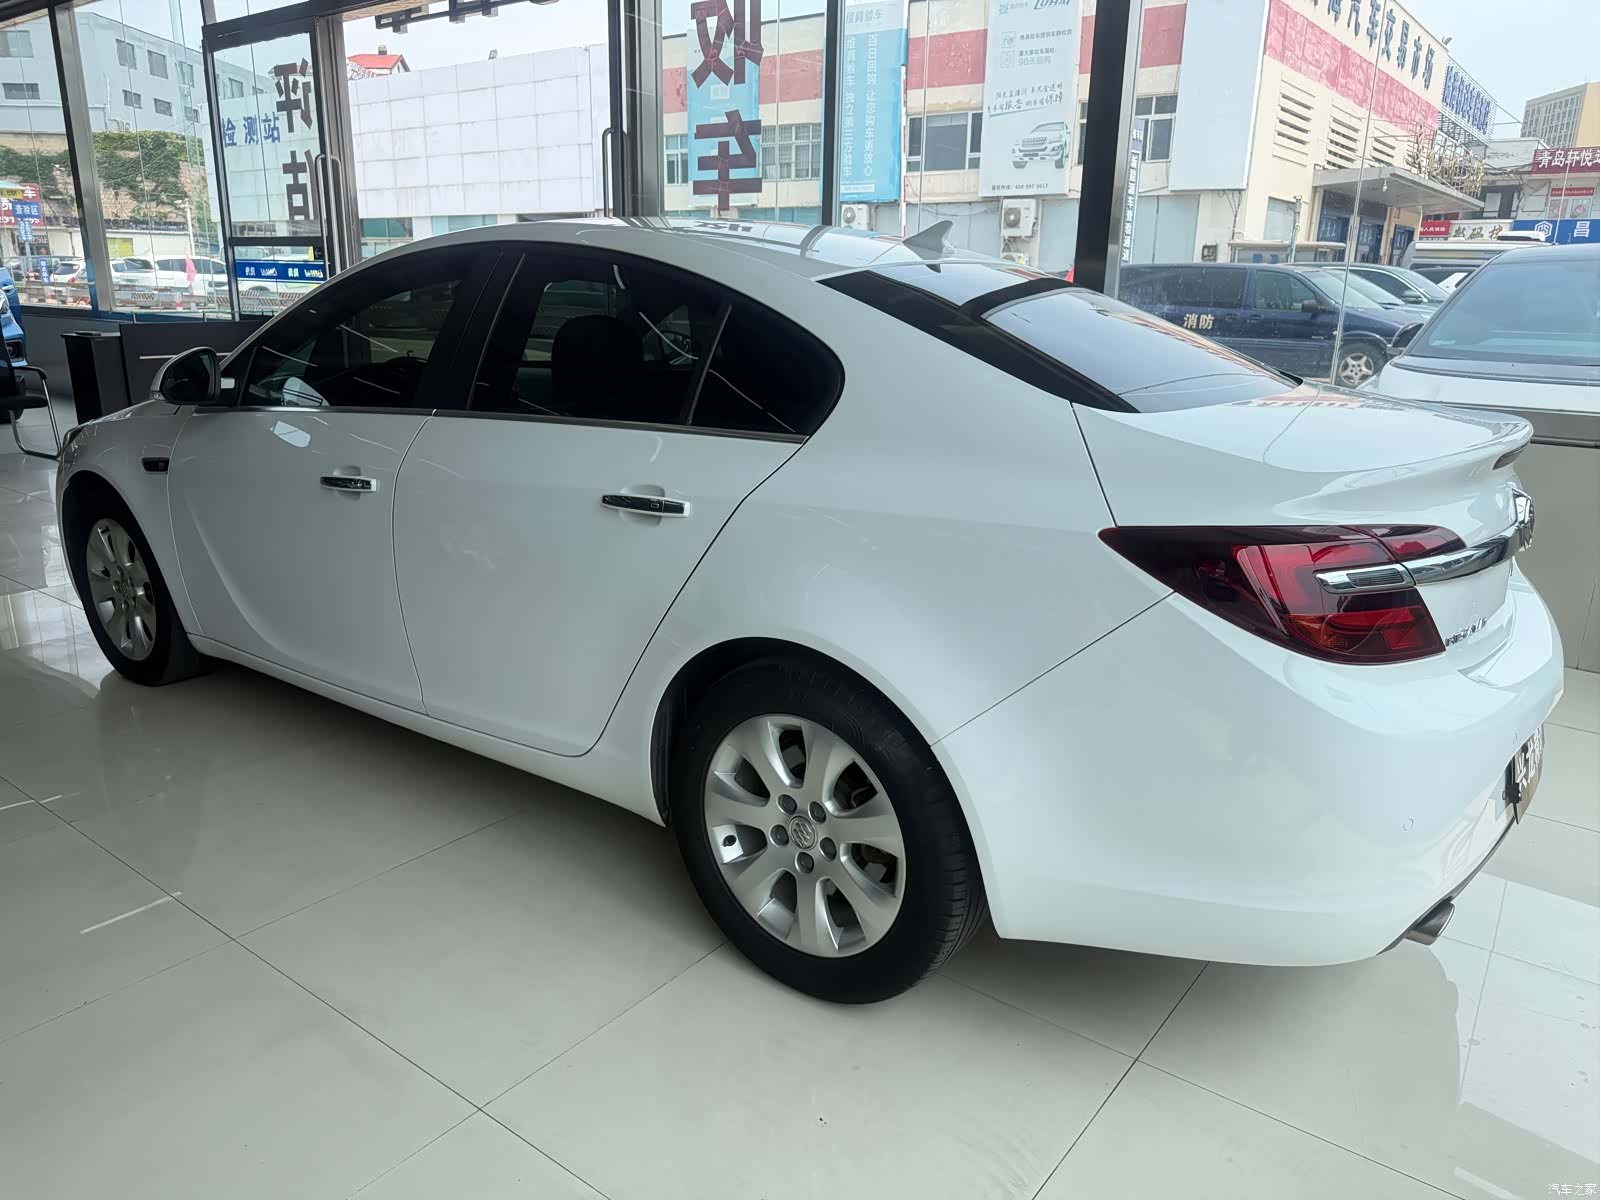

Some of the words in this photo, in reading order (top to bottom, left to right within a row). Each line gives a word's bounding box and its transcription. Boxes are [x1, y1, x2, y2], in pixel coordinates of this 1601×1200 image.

[222, 112, 281, 148] 检测站
[1574, 221, 1590, 237] 昌
[1183, 312, 1214, 330] 消防
